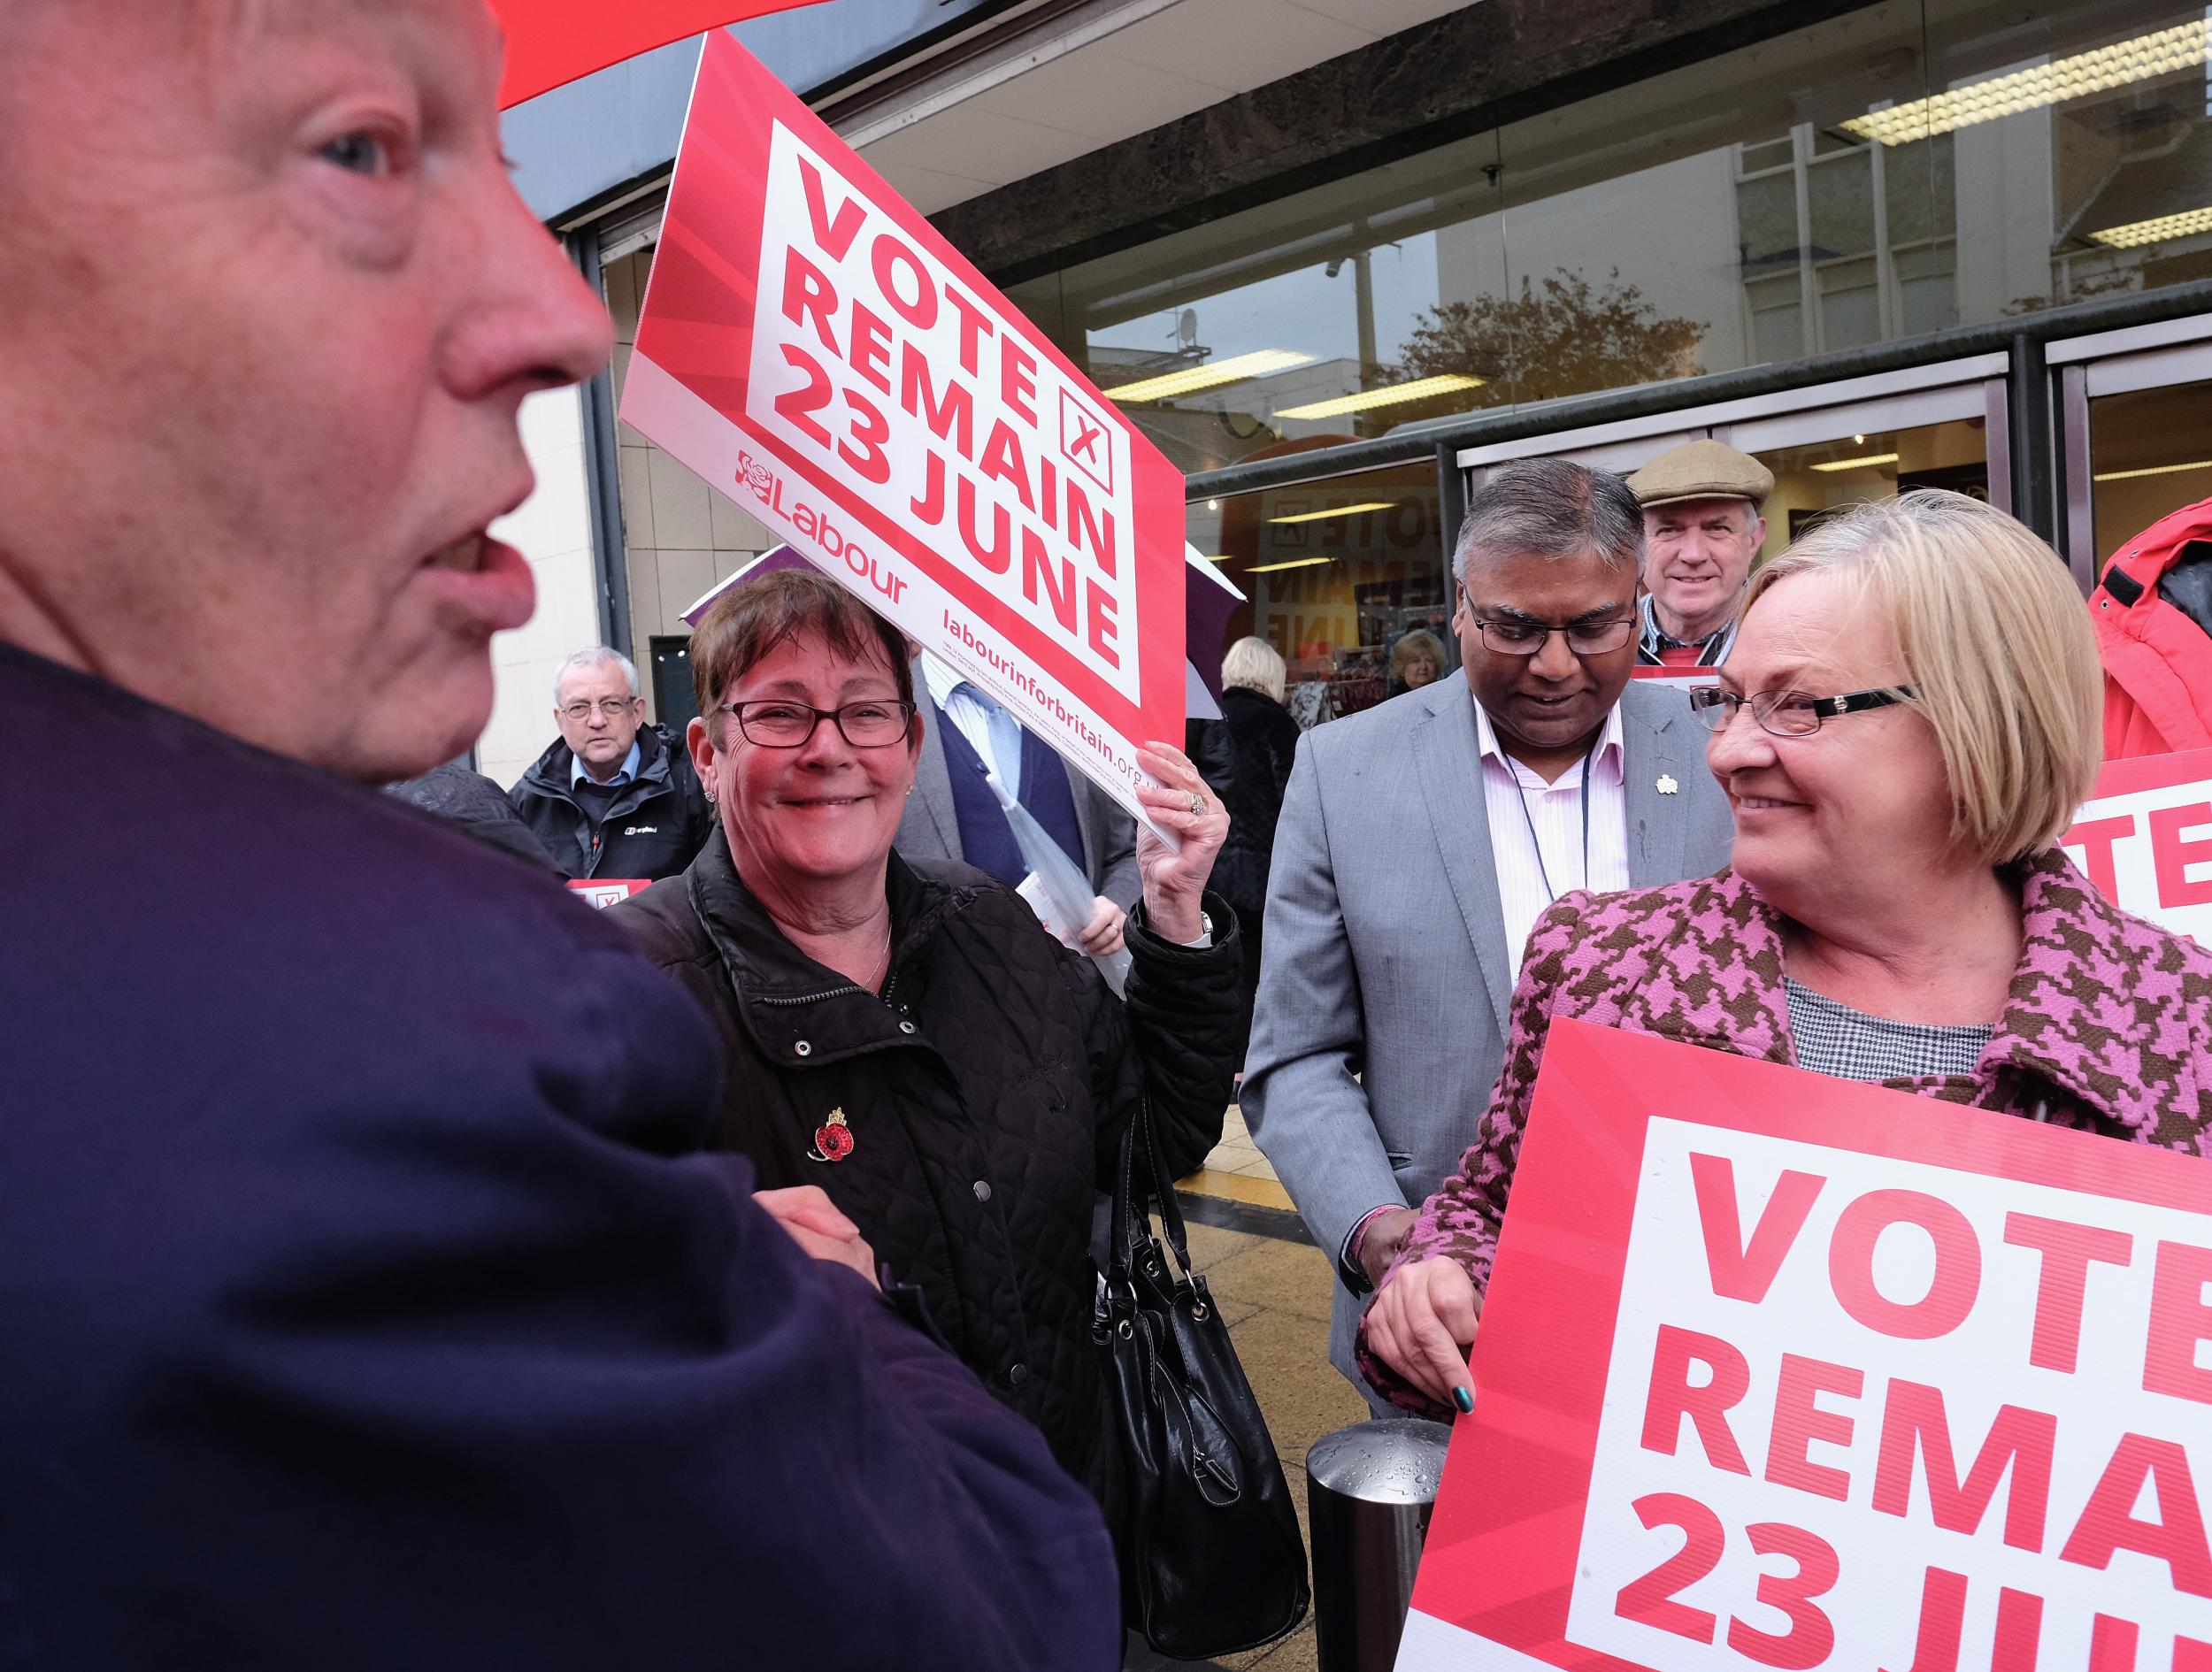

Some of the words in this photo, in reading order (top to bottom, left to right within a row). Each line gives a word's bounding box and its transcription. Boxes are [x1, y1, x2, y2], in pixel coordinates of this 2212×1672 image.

[782, 245, 1116, 579] REMAIN
[798, 156, 1037, 428] VOTE
[772, 478, 908, 605] Labour
[774, 343, 890, 484] 23
[910, 449, 1119, 669] JUNE
[1615, 1493, 1839, 1670] 23
[1640, 1324, 2212, 1599] REMA
